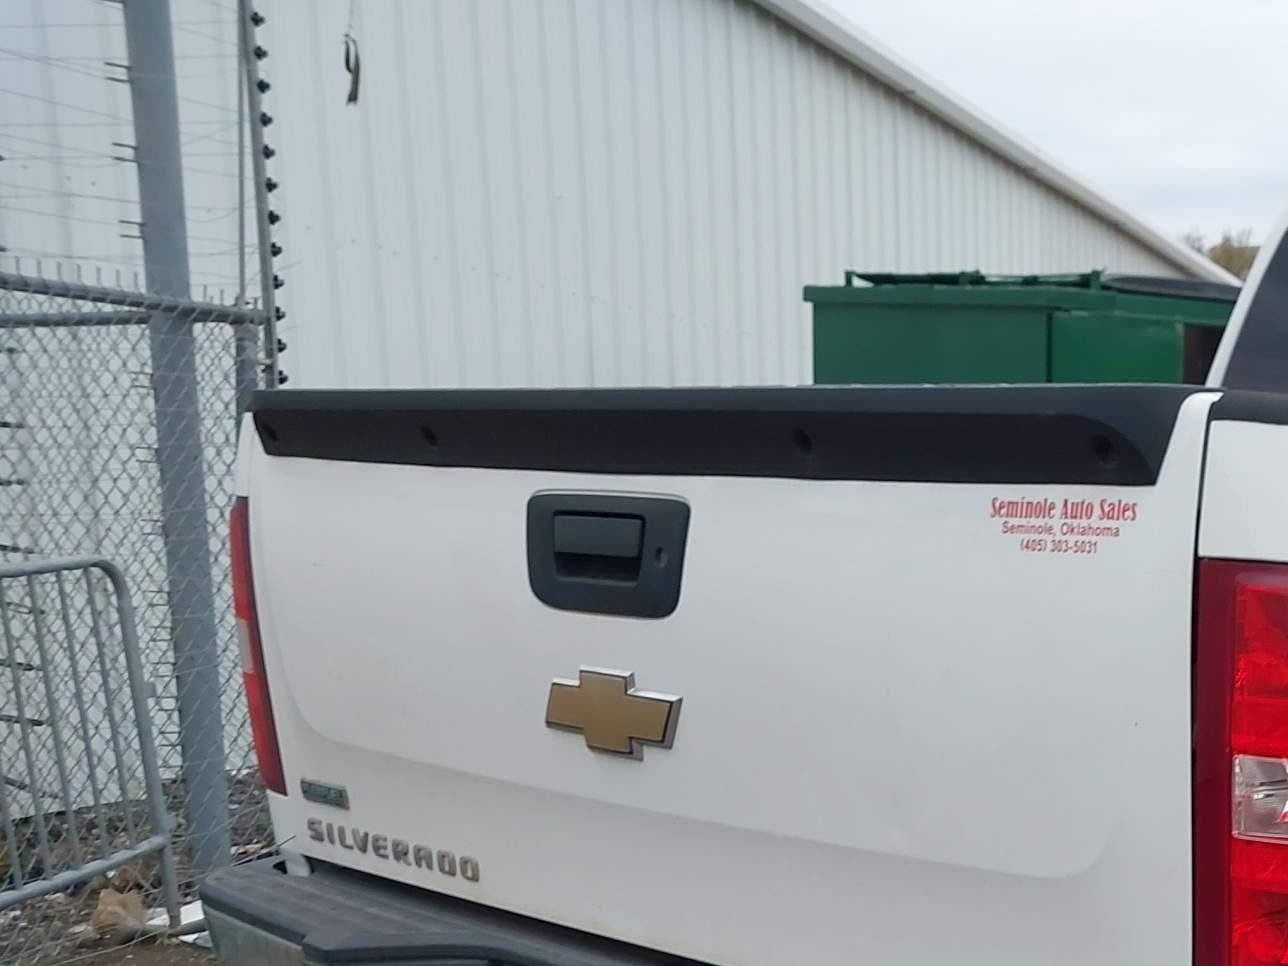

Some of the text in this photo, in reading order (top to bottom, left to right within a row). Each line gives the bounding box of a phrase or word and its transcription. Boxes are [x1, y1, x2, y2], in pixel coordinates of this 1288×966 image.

[990, 496, 1138, 521] Seminole Auto Sales
[1001, 520, 1121, 537] Seminole, Oklahoma
[1020, 538, 1098, 554] (405) 303-5031
[306, 816, 481, 883] SILVERADO
